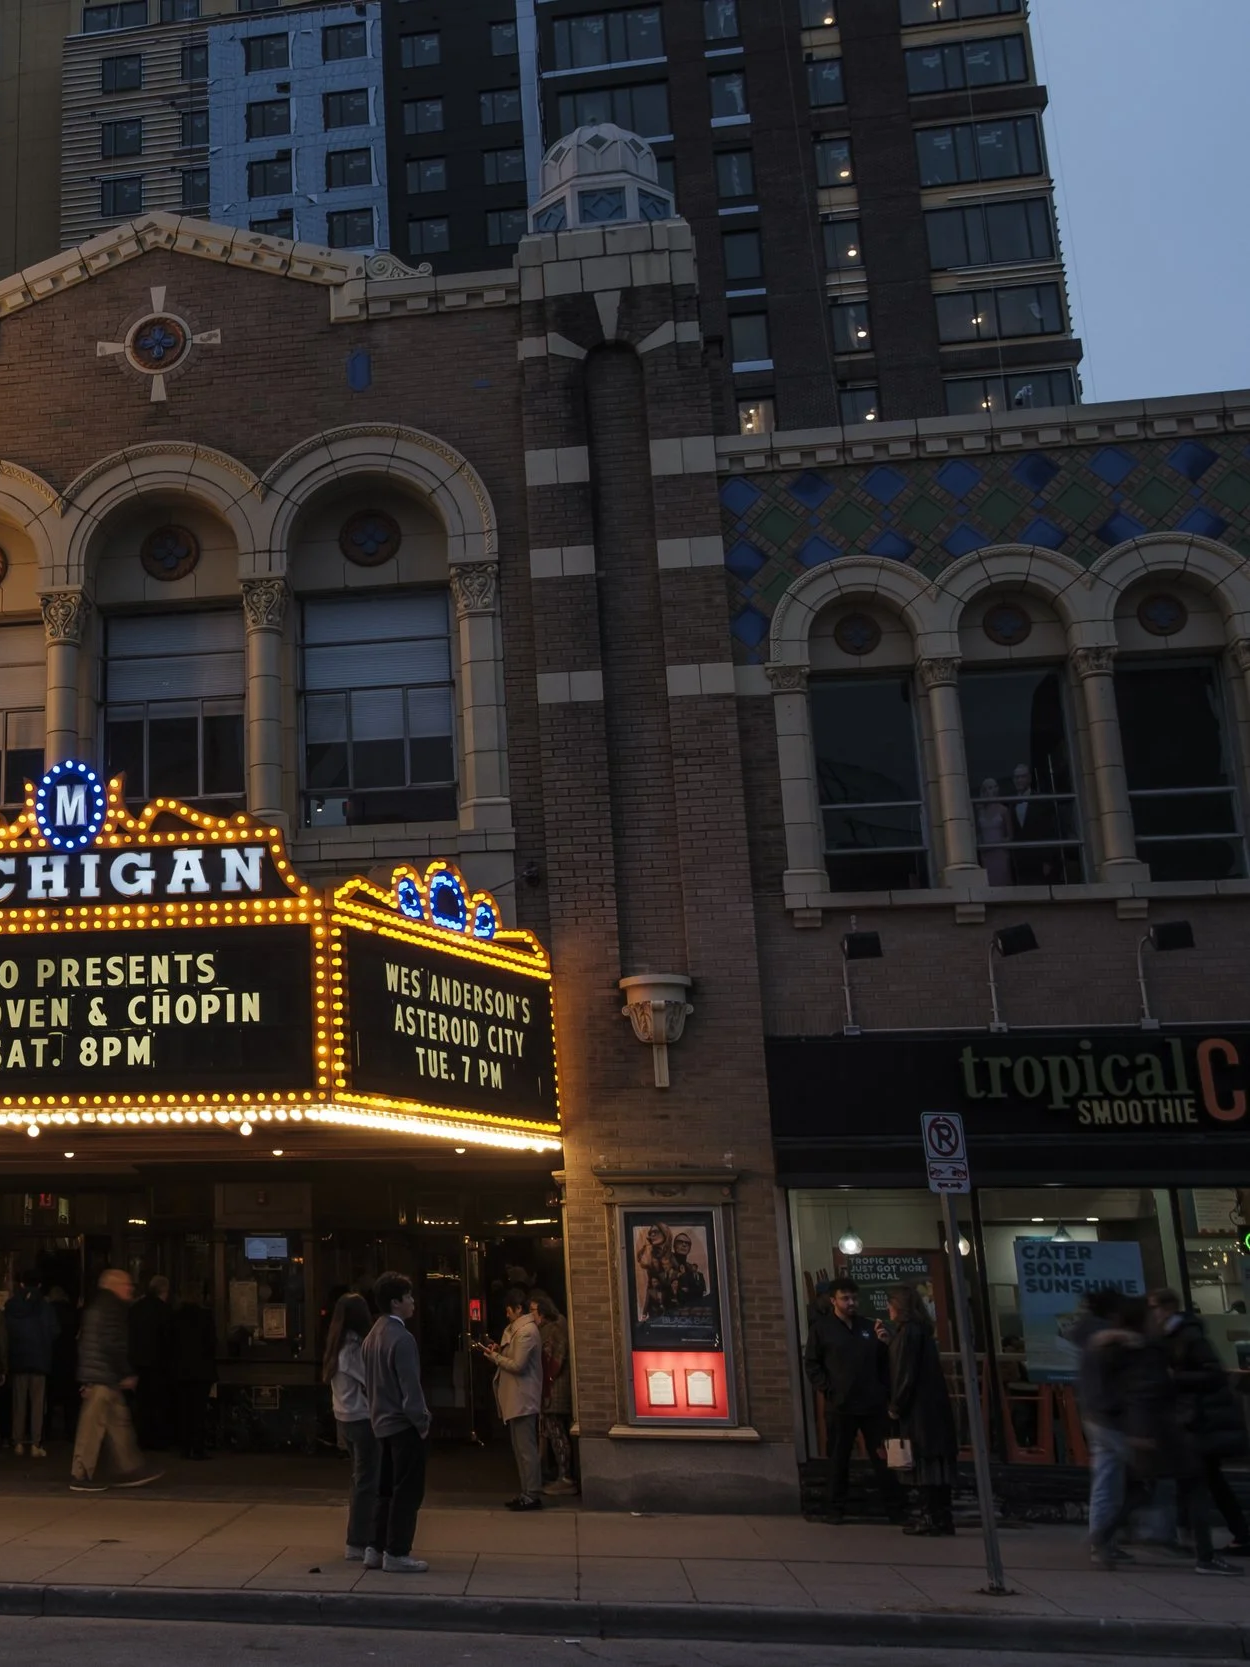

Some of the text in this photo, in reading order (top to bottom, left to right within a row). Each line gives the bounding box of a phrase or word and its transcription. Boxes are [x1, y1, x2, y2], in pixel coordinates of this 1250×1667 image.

[55, 784, 88, 827] M
[37, 953, 216, 988] PRESENTS
[88, 996, 108, 1026] &
[128, 991, 261, 1025] CHOPIN
[385, 962, 531, 1024] WES ANDERSON'S
[394, 1003, 525, 1058] ASTEROID CITY
[78, 1035, 152, 1066] 8PM
[416, 1046, 503, 1090] TUE. 7 PM
[959, 1037, 1195, 1110] tropical
[1077, 1097, 1199, 1125] SMOOTHIE
[849, 1256, 924, 1265] TROPIC BOWLS
[850, 1264, 928, 1273] JUST GOT MORE
[1021, 1245, 1093, 1260] CATER
[1023, 1262, 1086, 1277] SOME
[1025, 1278, 1138, 1294] SUNSHINE
